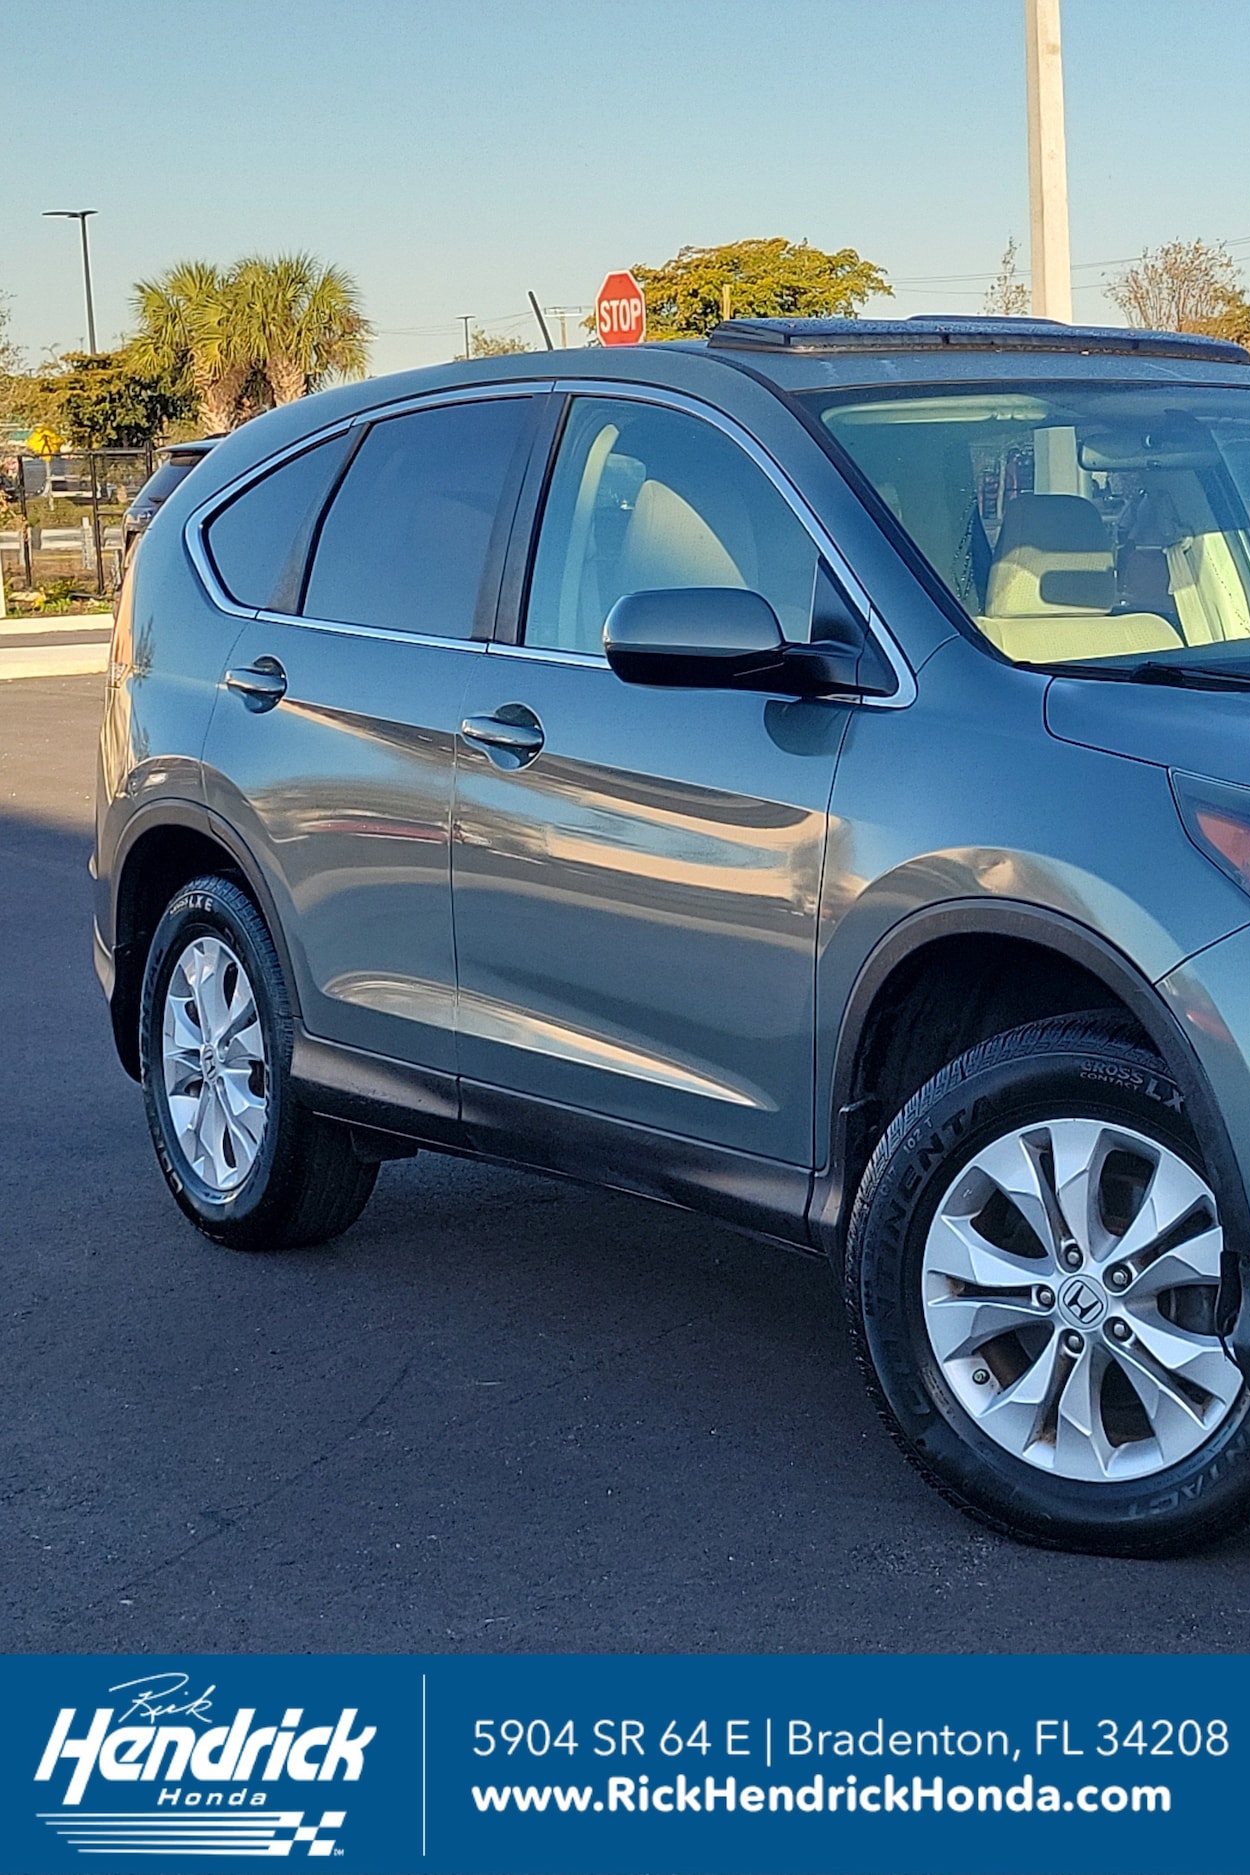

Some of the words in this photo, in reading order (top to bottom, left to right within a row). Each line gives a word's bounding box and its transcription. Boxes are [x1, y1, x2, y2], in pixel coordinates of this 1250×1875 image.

[600, 298, 642, 333] STOP
[1080, 1060, 1144, 1086] CROSS
[1080, 1071, 1139, 1091] CONTACT
[1145, 1078, 1186, 1114] LX
[903, 1128, 921, 1154] 102
